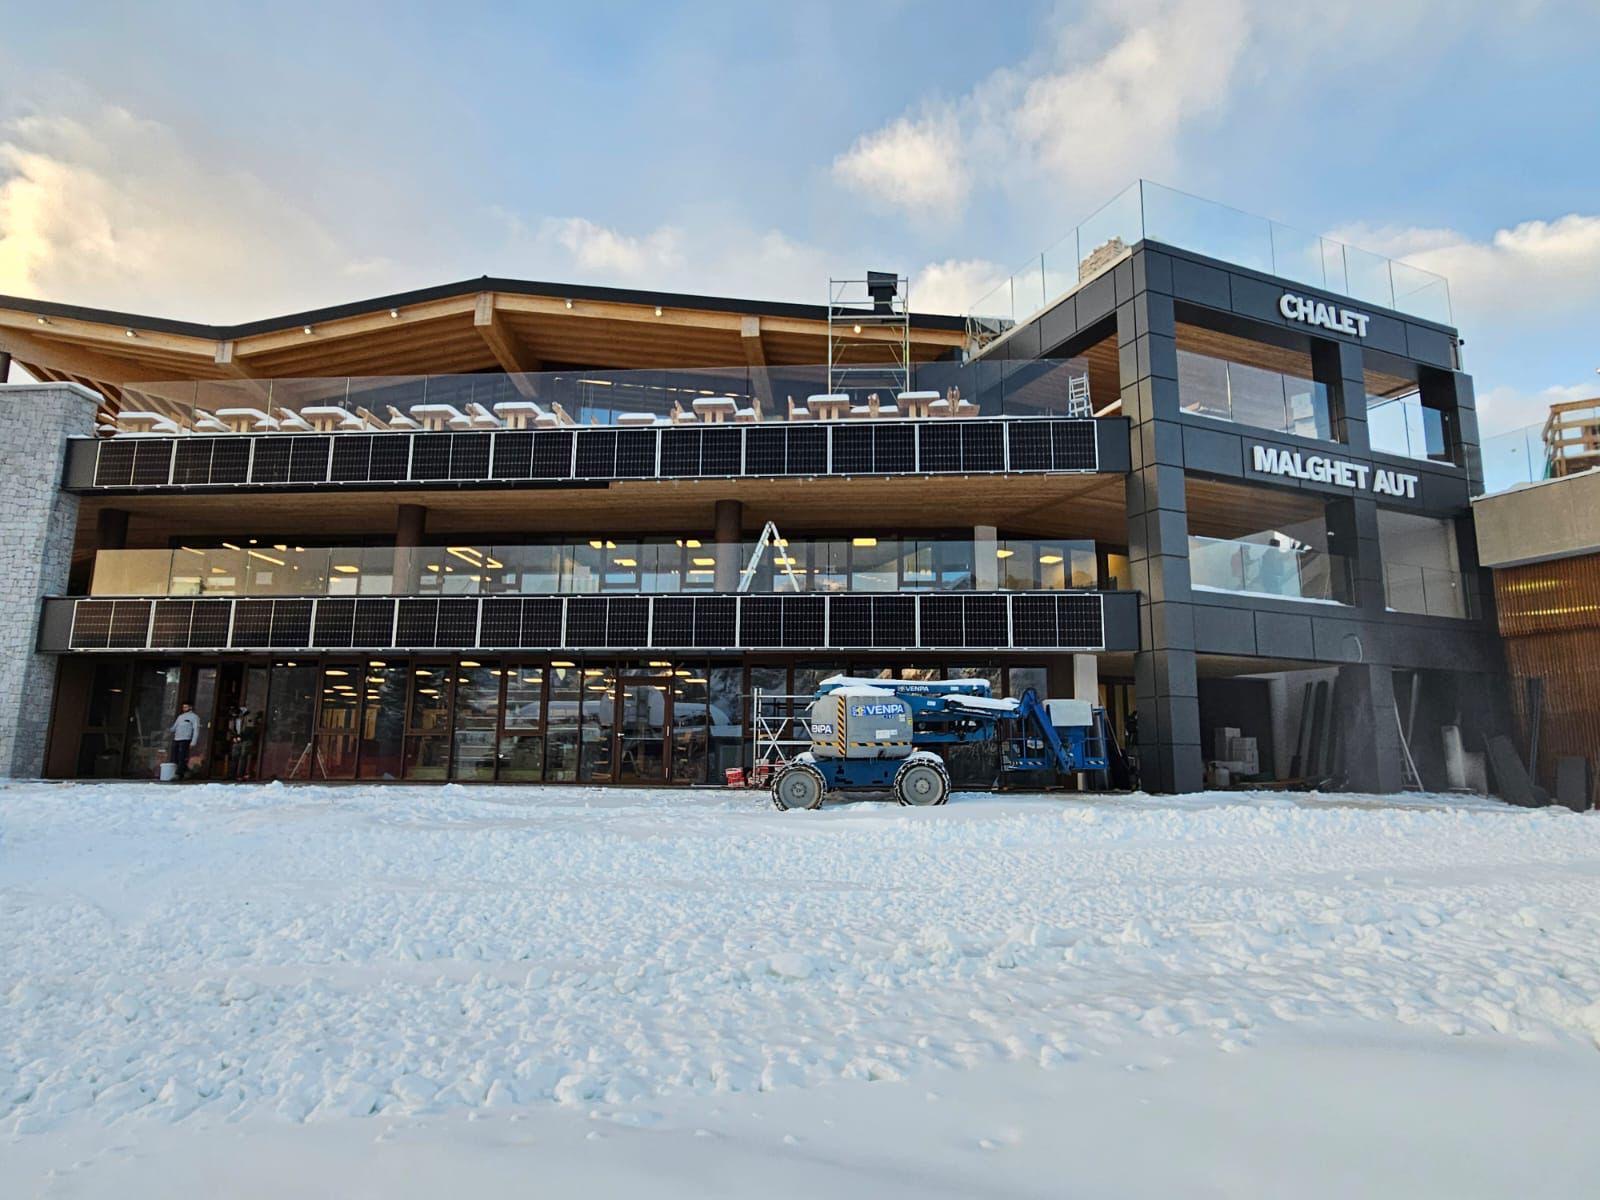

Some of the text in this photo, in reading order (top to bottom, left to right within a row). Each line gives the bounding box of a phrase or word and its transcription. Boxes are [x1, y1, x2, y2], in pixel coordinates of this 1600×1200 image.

[1279, 293, 1370, 337] CHALET
[1253, 445, 1418, 498] MALGHET AUT
[866, 704, 904, 715] VENPA
